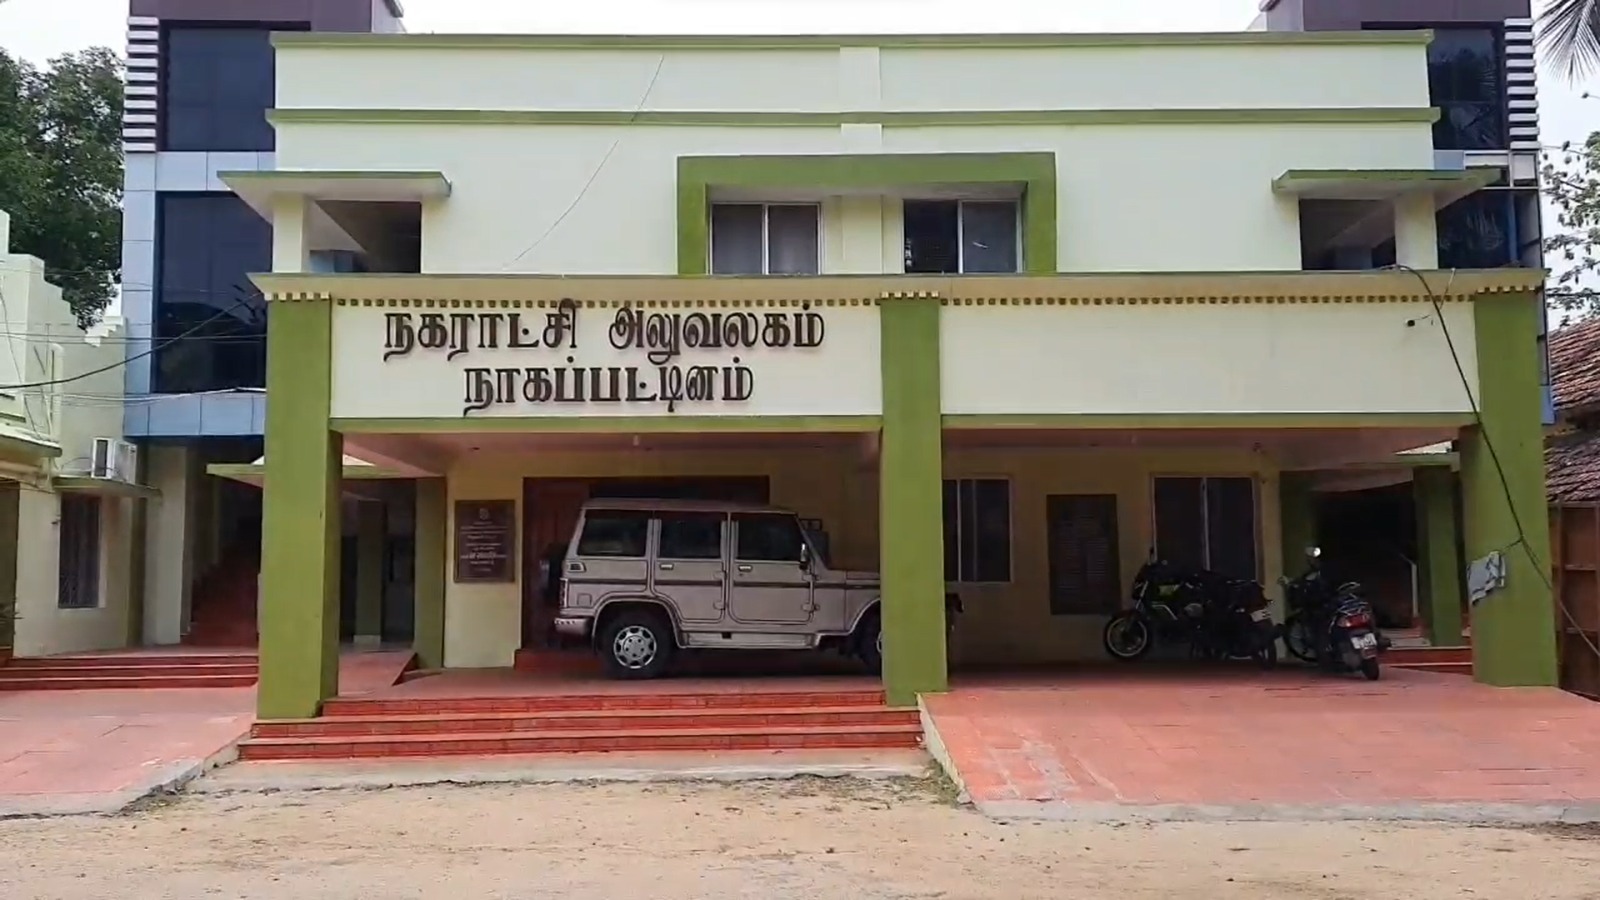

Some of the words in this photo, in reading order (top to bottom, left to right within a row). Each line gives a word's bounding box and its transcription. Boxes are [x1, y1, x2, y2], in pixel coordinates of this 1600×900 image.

[384, 299, 577, 361] நகராட்சி
[609, 302, 824, 364] அலுவலகம்
[463, 356, 753, 416] நாகப்பட்டினம்
